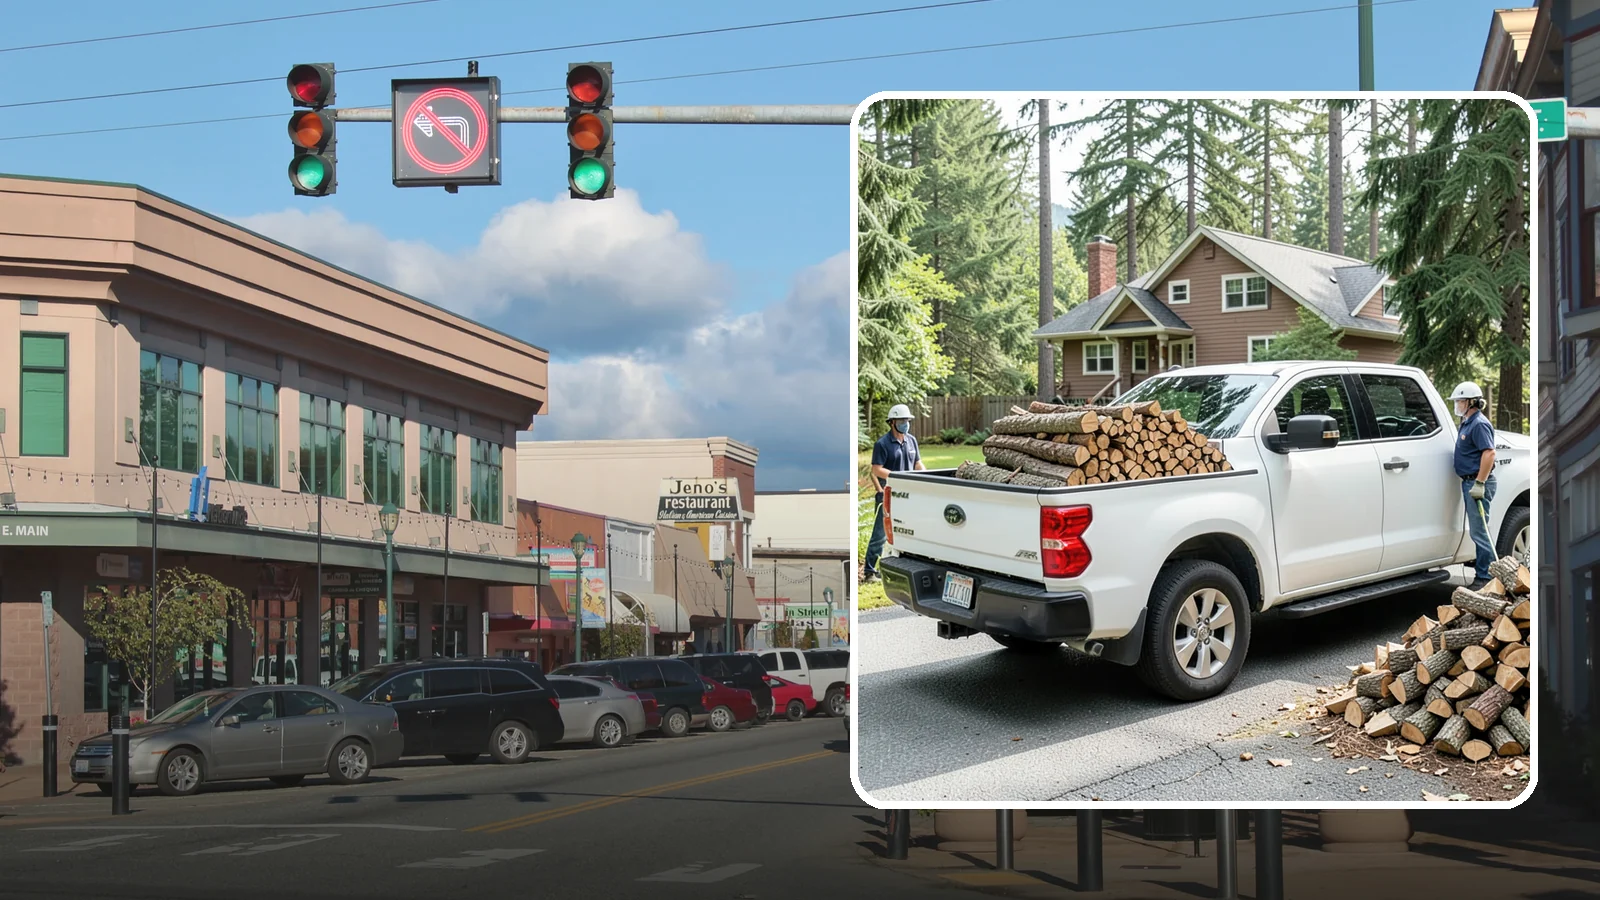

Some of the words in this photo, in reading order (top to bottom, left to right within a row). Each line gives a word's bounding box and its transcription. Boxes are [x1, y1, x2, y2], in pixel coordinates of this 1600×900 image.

[670, 480, 728, 494] Jeno's
[665, 497, 731, 509] restaurant
[658, 510, 681, 520] Italian
[686, 510, 714, 519] American
[715, 509, 737, 519] Cuisine
[2, 525, 13, 536] E.
[15, 525, 49, 536] MAIN
[797, 607, 828, 616] Street
